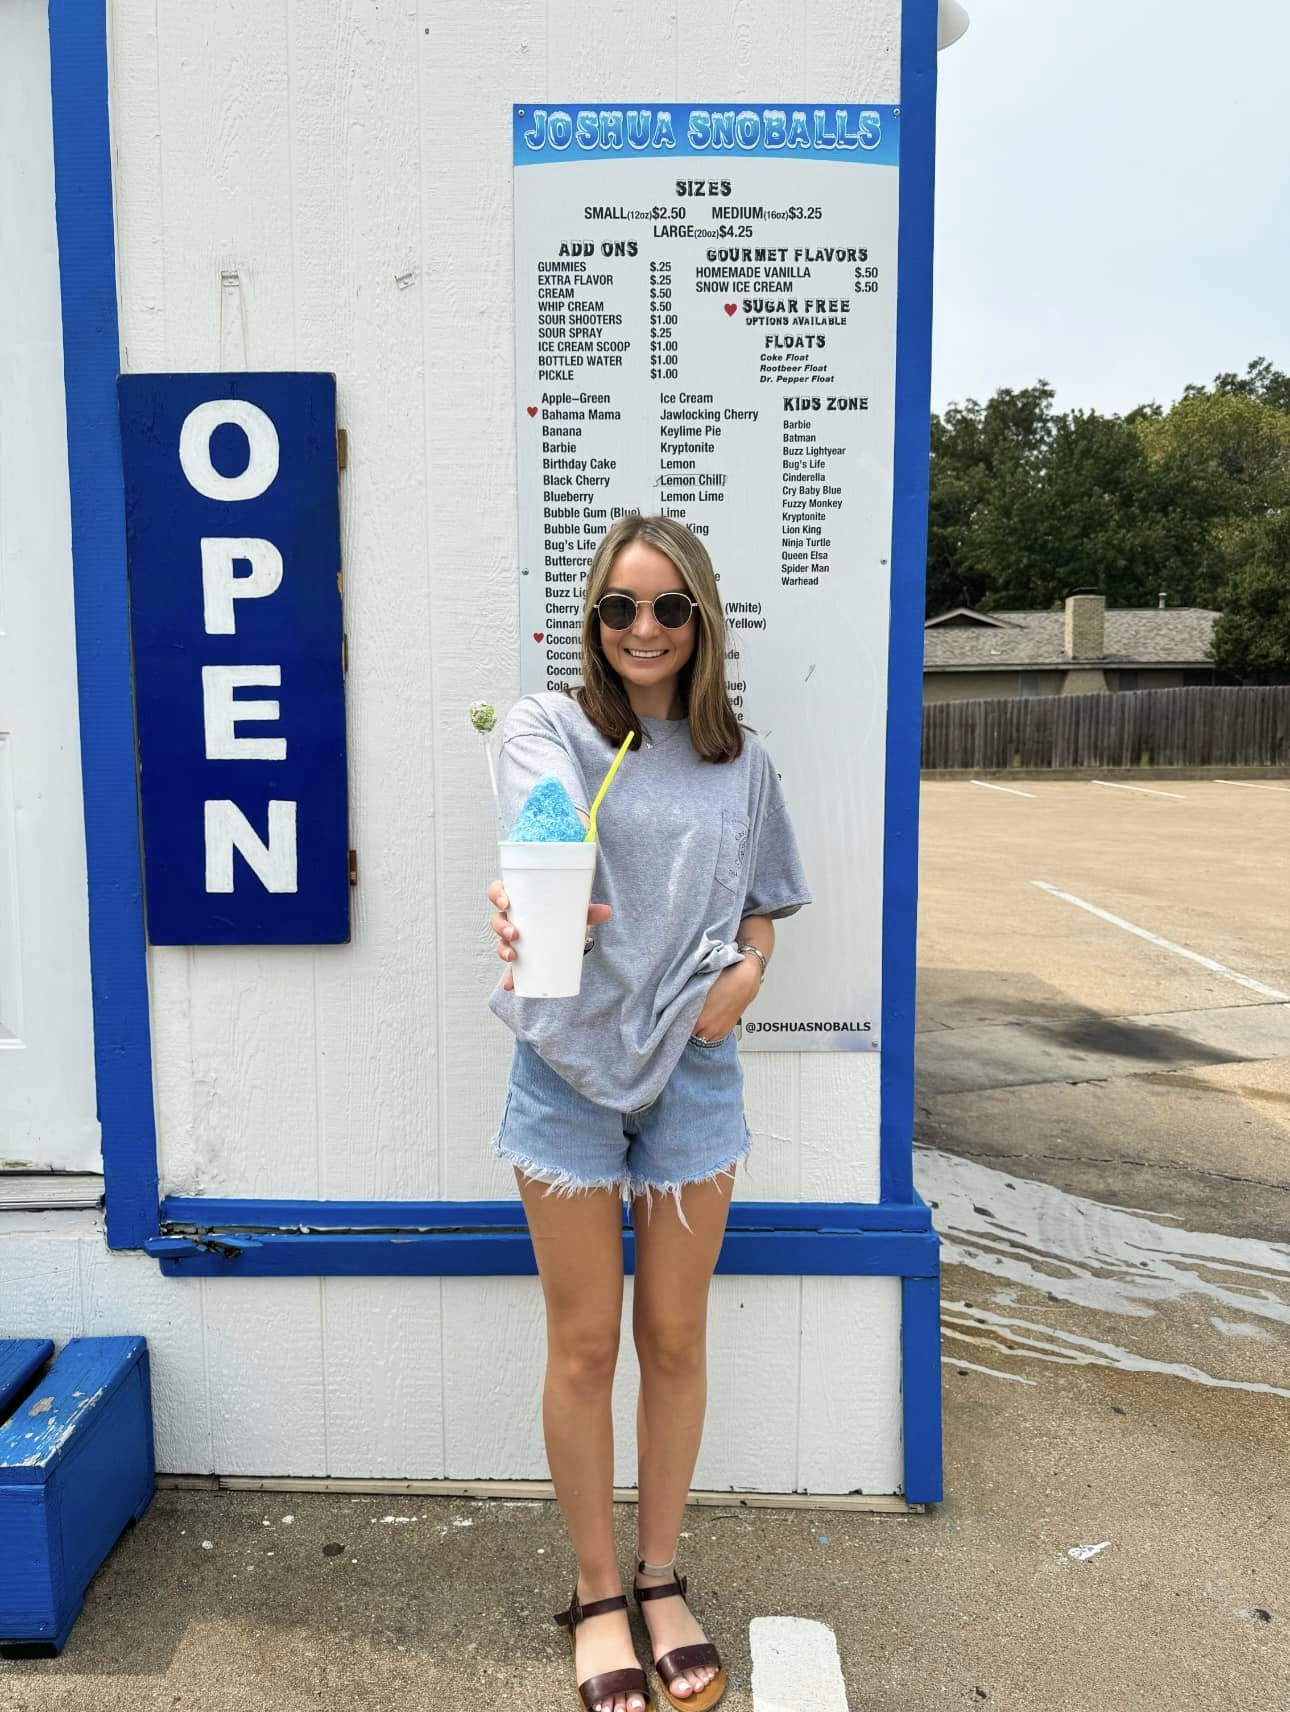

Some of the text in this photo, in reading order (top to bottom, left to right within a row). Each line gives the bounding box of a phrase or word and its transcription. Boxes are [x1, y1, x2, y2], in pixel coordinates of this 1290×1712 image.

[525, 109, 882, 149] JOSHUA SNOBALLS
[676, 179, 731, 197] SIZES
[559, 240, 638, 257] ADD ONS
[707, 248, 868, 262] GOURMET FLAVORS
[538, 261, 671, 272] GUMMIES $.25
[696, 267, 878, 279] HOMEMADE VANILLA $.50
[538, 275, 671, 286] EXTRA FLAVOR $.25
[696, 281, 878, 293] SNOW ICE CREAM $.50
[538, 288, 671, 299] CREAM $.50
[538, 301, 671, 312] WHIP CREAM $.50
[743, 298, 850, 313] SUGAR FREE
[539, 314, 678, 325] SOUR SHOOTERS $1.00
[746, 316, 846, 325] OPTIONS AVAILABLE
[539, 327, 671, 339] SOUR SPRAY $.25
[539, 340, 678, 352] ICE CREAM SCOOP $1.00
[765, 335, 825, 348] FLOATS
[539, 354, 678, 366] BOTTLED WATER $1.00
[539, 369, 678, 380] PICKLE $1.00
[776, 375, 809, 384] Pepper
[661, 392, 713, 403] Ice Cream
[784, 397, 868, 411] KIDS ZONE
[542, 409, 620, 420] Bahama Mama
[660, 409, 758, 422] Jawlocking Cherry
[784, 420, 811, 429] Barbie
[543, 426, 581, 436] Banana
[661, 425, 721, 438] Keylime Pie
[784, 434, 816, 442] Batman
[543, 442, 576, 453] Barbie
[661, 442, 714, 455] Kryptonite
[783, 446, 846, 457] Buzz Lightyear
[543, 458, 616, 471] Birthday Cake
[661, 459, 695, 469] Lemon
[783, 460, 825, 470] Bug's Life
[544, 475, 610, 488] Black Cherry
[661, 475, 695, 486] Lemon
[783, 473, 825, 482] Cinderella
[661, 491, 724, 502] Lemon Lime
[783, 486, 841, 496] Cry Baby Blue
[544, 491, 594, 504] Blueberry
[783, 499, 842, 509] Fuzzy Monkey
[544, 507, 580, 518] Bubble
[583, 507, 606, 518] Gum
[661, 507, 685, 518] Lime
[783, 512, 825, 522] Kryptonite
[544, 524, 580, 535] Bubble
[584, 524, 606, 535] Gum
[782, 525, 821, 535] Lion King
[545, 540, 596, 552] Bug's Life
[782, 538, 830, 548] Ninja Turtle
[545, 556, 592, 566] Buttercre
[782, 551, 828, 560] Queen Elsa
[781, 564, 829, 574] Spider Man
[545, 572, 577, 582] Butter
[782, 576, 818, 585] Warhead
[545, 588, 570, 598] Buzz
[546, 603, 578, 615] Cherry
[725, 603, 761, 614] (White)
[179, 399, 297, 894] OPEN
[547, 681, 569, 692] Cola
[745, 1021, 871, 1033] @JOSHUASNOBALLS
